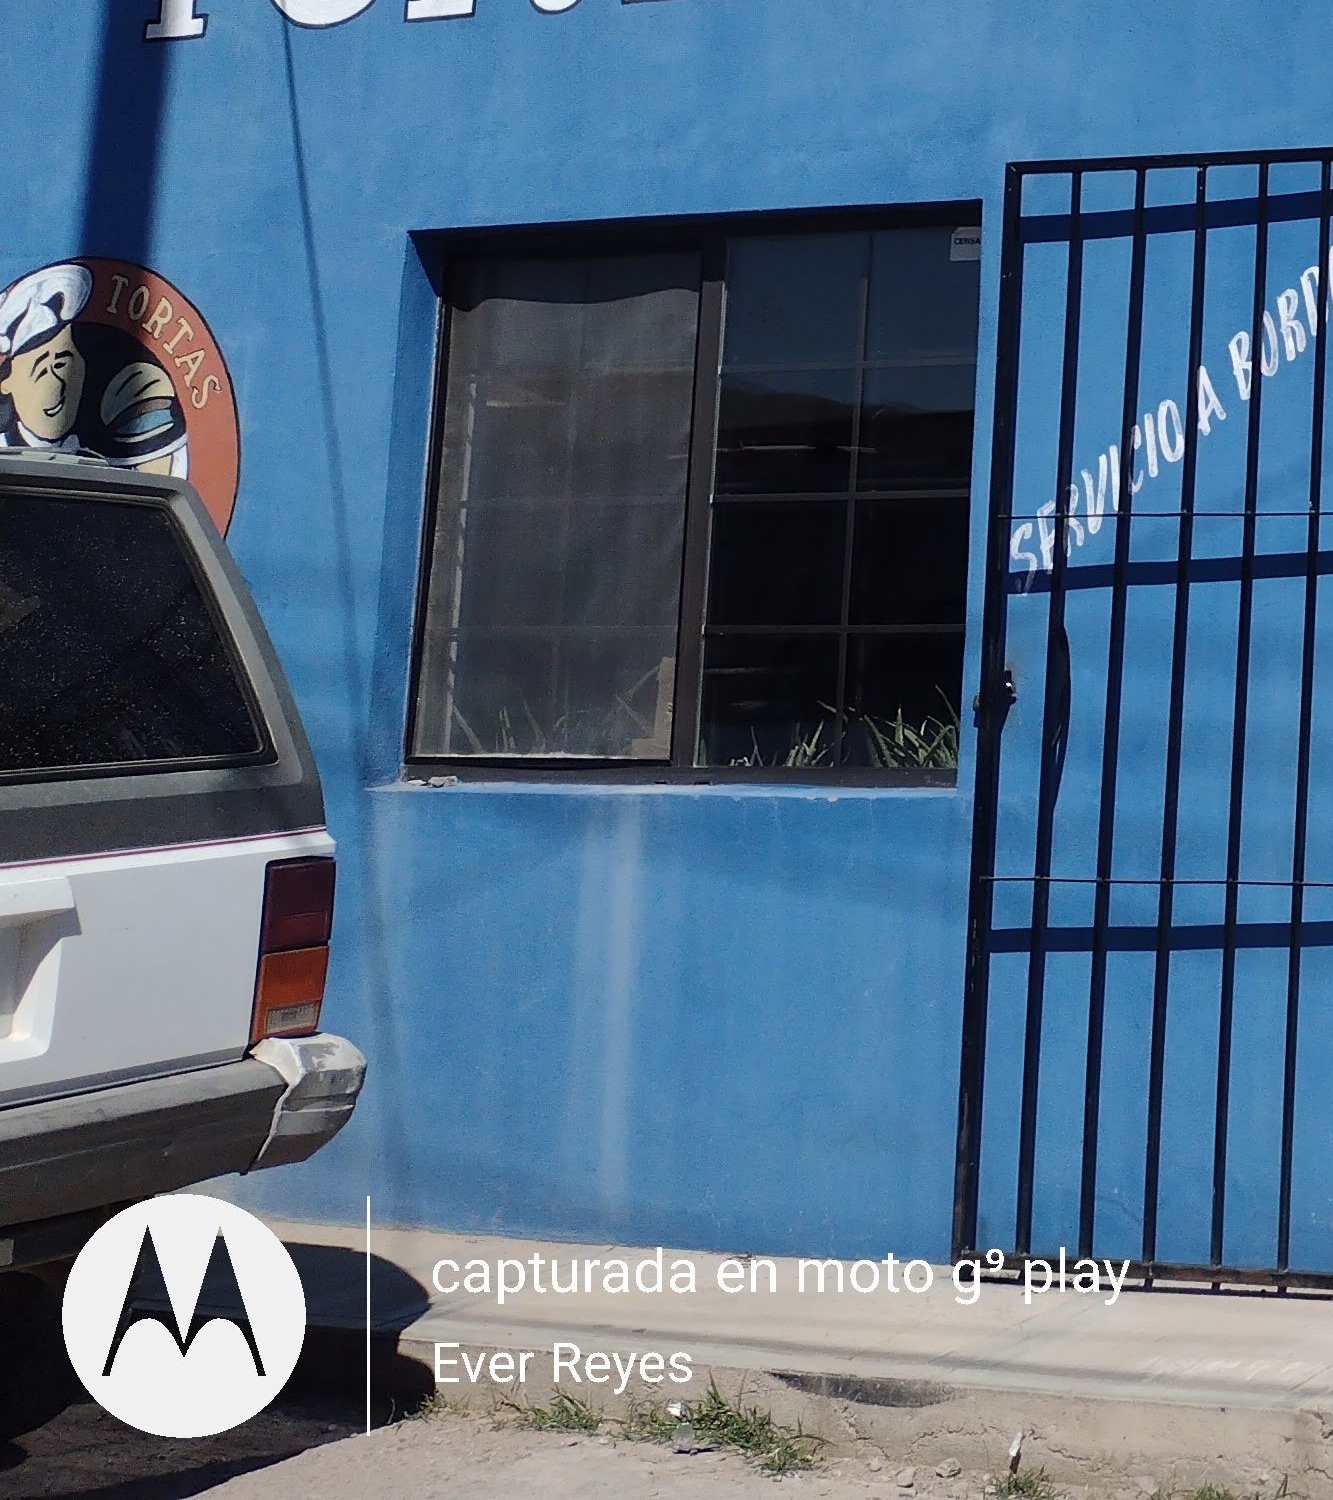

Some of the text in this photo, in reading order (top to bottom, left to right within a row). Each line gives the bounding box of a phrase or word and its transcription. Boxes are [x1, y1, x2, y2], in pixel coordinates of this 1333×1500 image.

[109, 274, 223, 410] TORTAS
[1010, 399, 1186, 596] SERVICIO
[1197, 365, 1227, 436] A
